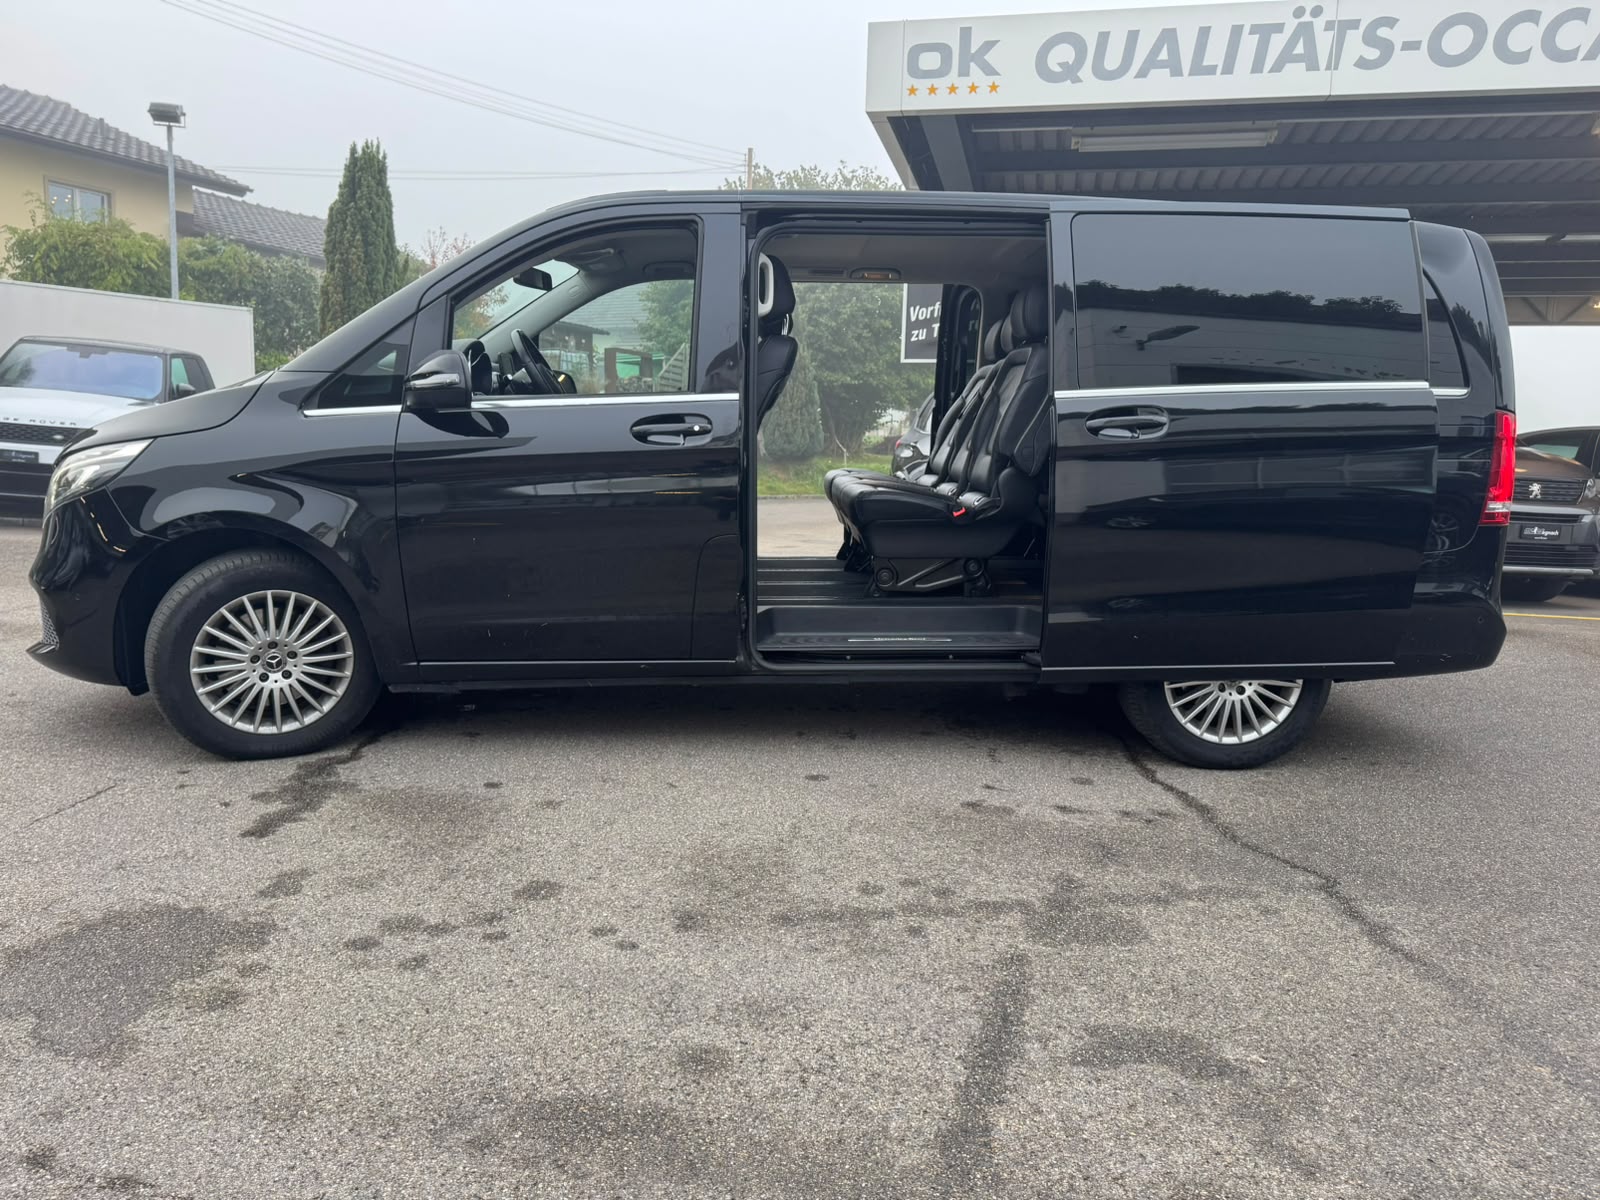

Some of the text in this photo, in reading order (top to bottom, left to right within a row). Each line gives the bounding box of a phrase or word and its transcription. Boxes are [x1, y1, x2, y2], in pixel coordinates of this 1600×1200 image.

[907, 26, 1002, 80] ok
[910, 302, 942, 322] Vorf
[911, 329, 927, 342] zu
